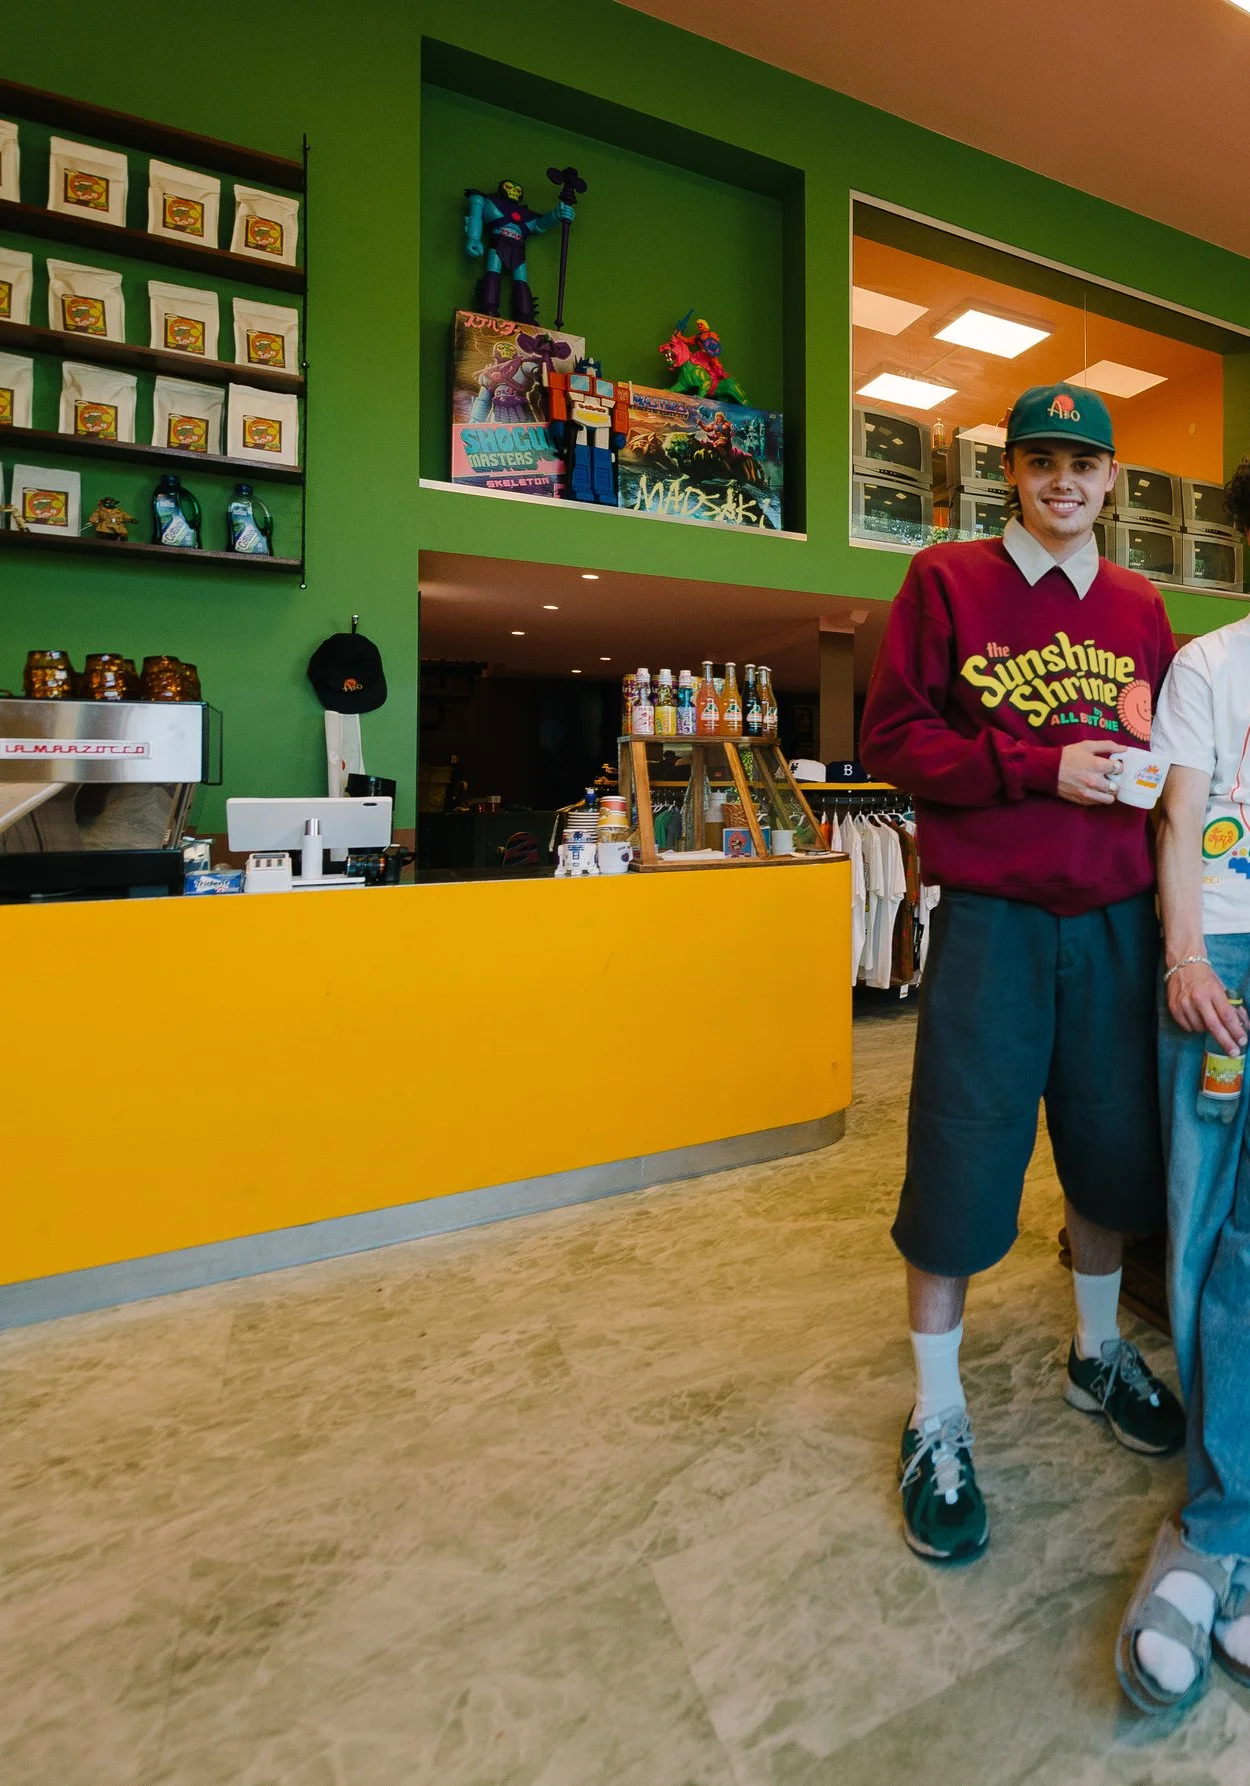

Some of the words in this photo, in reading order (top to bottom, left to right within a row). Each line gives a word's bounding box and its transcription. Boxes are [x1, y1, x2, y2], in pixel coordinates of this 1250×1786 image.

[461, 427, 554, 454] SHOGU
[467, 451, 534, 468] MASTERS
[486, 477, 550, 488] SKELETOR
[987, 642, 1010, 658] the
[960, 631, 1135, 708] Sunshine
[1009, 671, 1118, 727] Shrine
[1051, 711, 1079, 725] ALL
[1080, 712, 1101, 727] BUT
[1099, 717, 1119, 732] ONE
[844, 764, 853, 776] B
